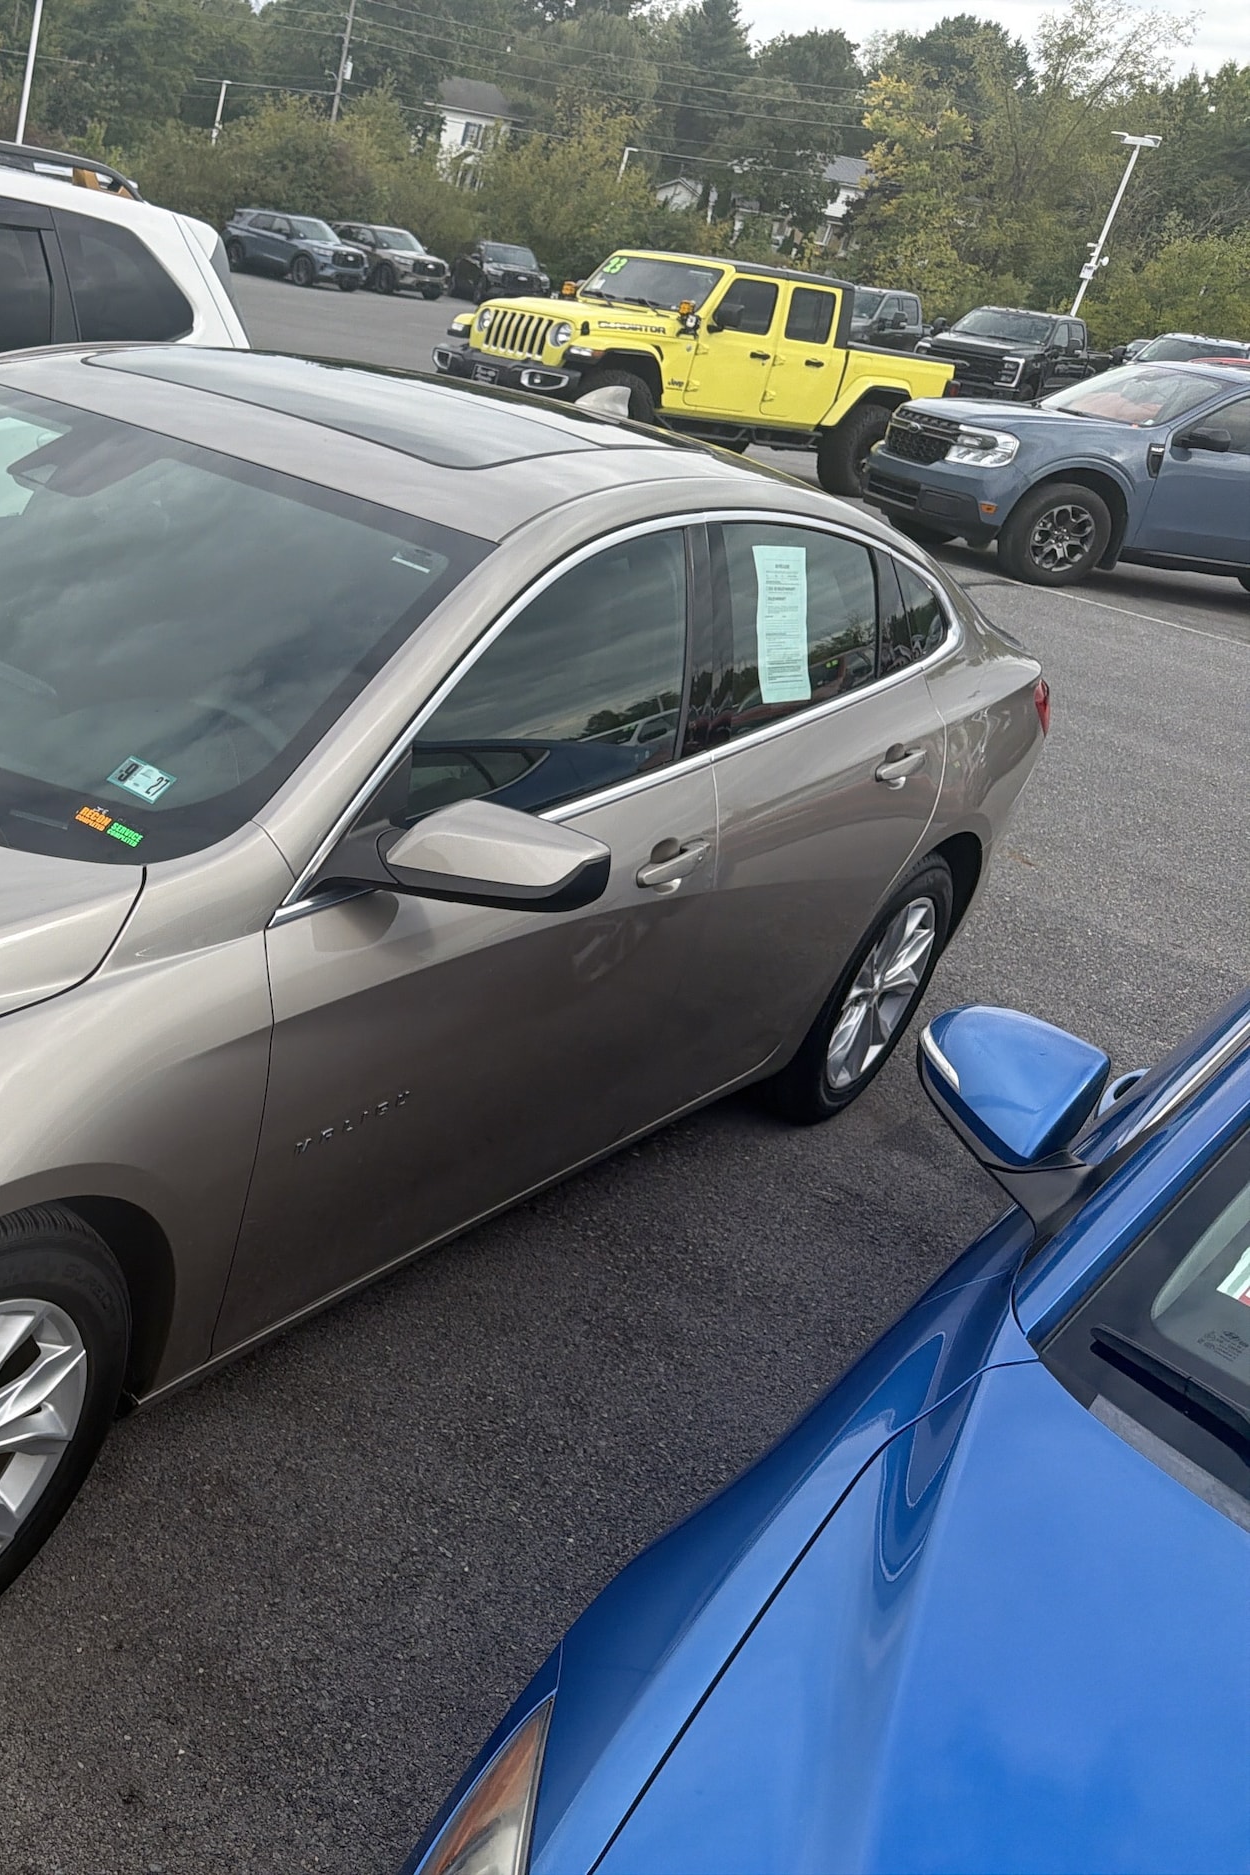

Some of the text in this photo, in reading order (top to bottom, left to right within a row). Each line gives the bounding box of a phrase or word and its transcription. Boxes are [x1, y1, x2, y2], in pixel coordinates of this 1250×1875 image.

[602, 256, 629, 274] 23
[597, 320, 666, 335] GLADIATOR
[667, 378, 684, 388] Jeep
[117, 763, 139, 782] 9
[145, 776, 170, 797] 27
[79, 806, 112, 827] RECON
[111, 822, 143, 842] SERVICE
